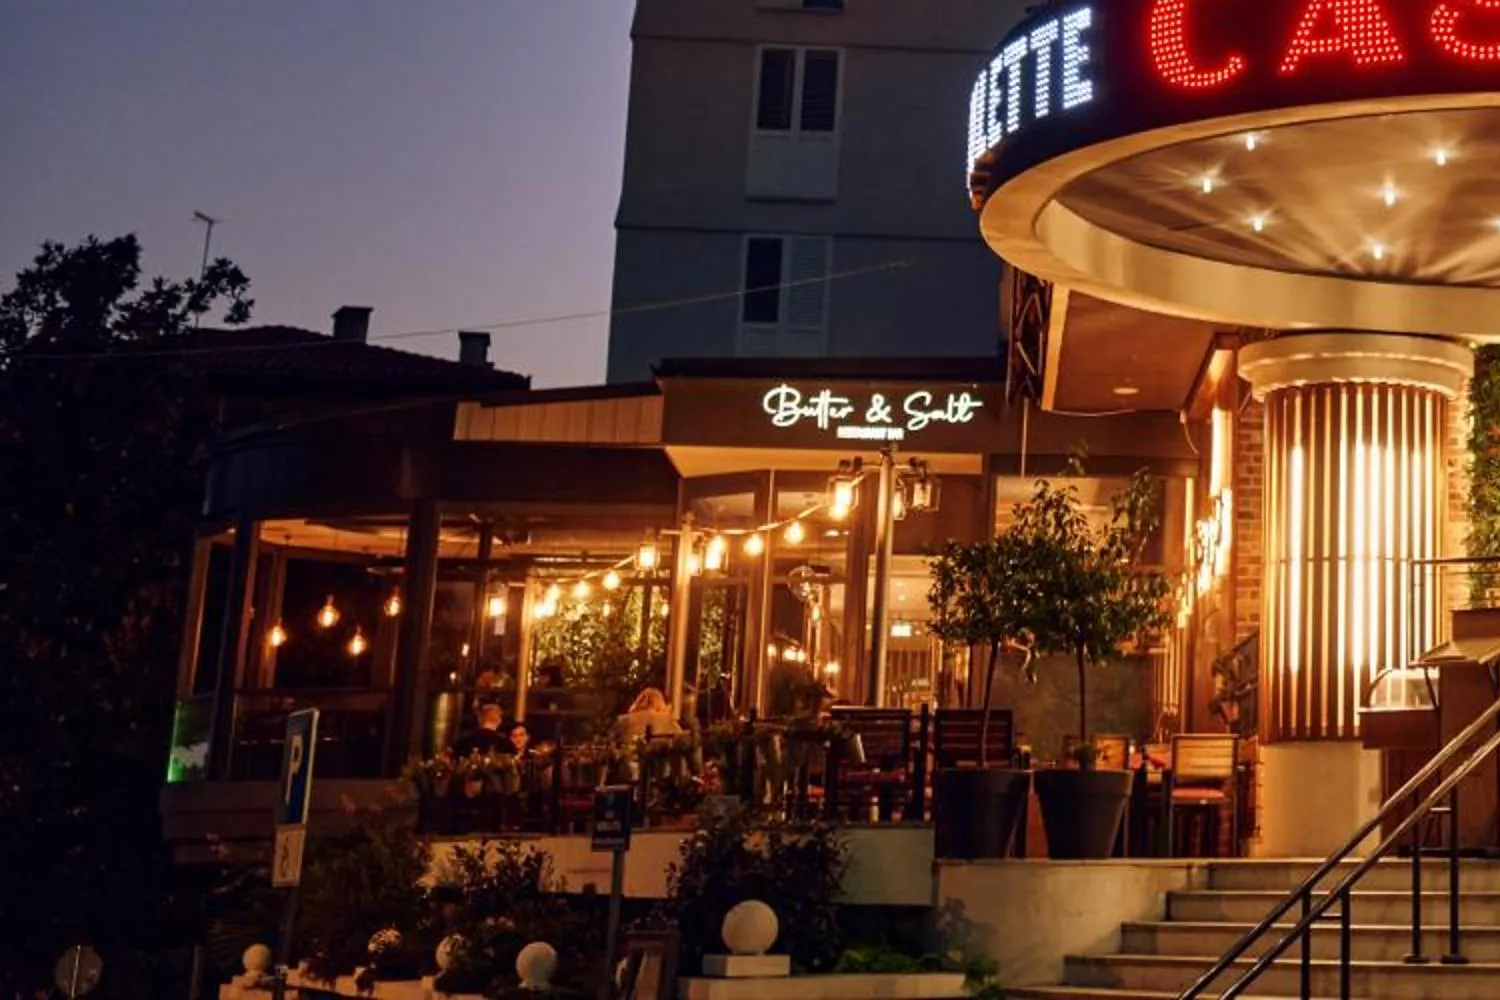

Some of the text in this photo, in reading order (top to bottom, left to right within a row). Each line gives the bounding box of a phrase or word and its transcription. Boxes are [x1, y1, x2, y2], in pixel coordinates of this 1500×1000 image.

[762, 383, 983, 431] Butter & Salt
